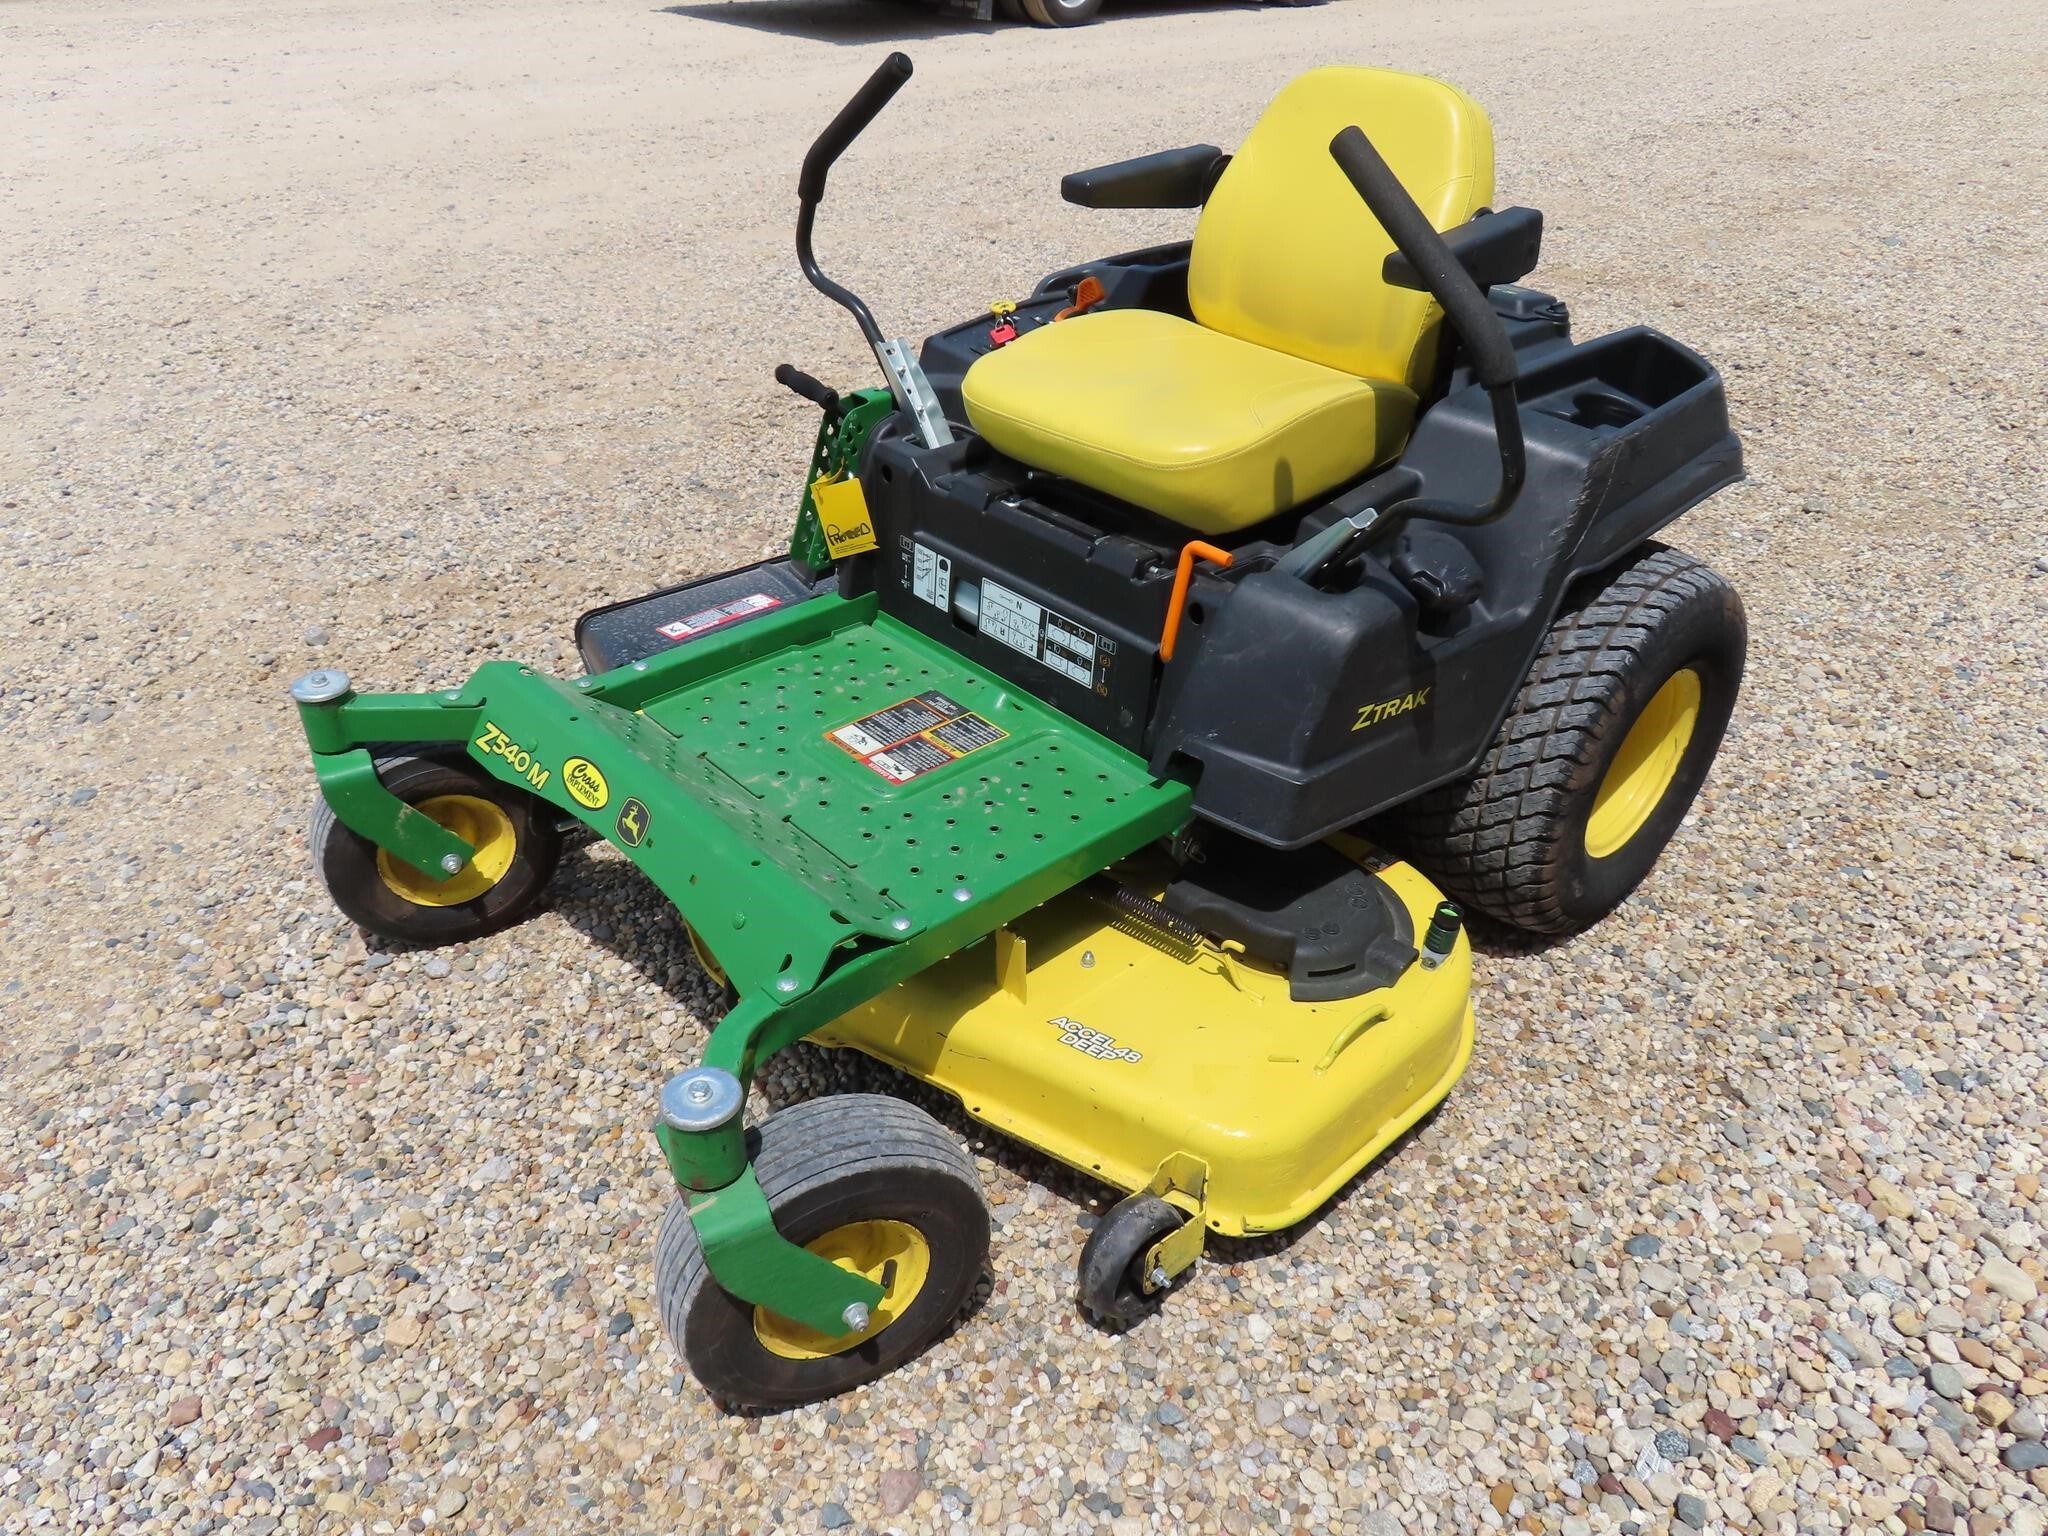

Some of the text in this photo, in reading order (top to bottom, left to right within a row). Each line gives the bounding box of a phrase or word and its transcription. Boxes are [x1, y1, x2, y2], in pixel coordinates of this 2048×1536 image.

[1351, 686, 1432, 732] ZTRAK
[566, 772, 600, 807] IMPLEMENT
[571, 763, 600, 793] Cross
[1046, 1016, 1116, 1052] ACCEL
[1057, 1032, 1143, 1064] DEEP 48
